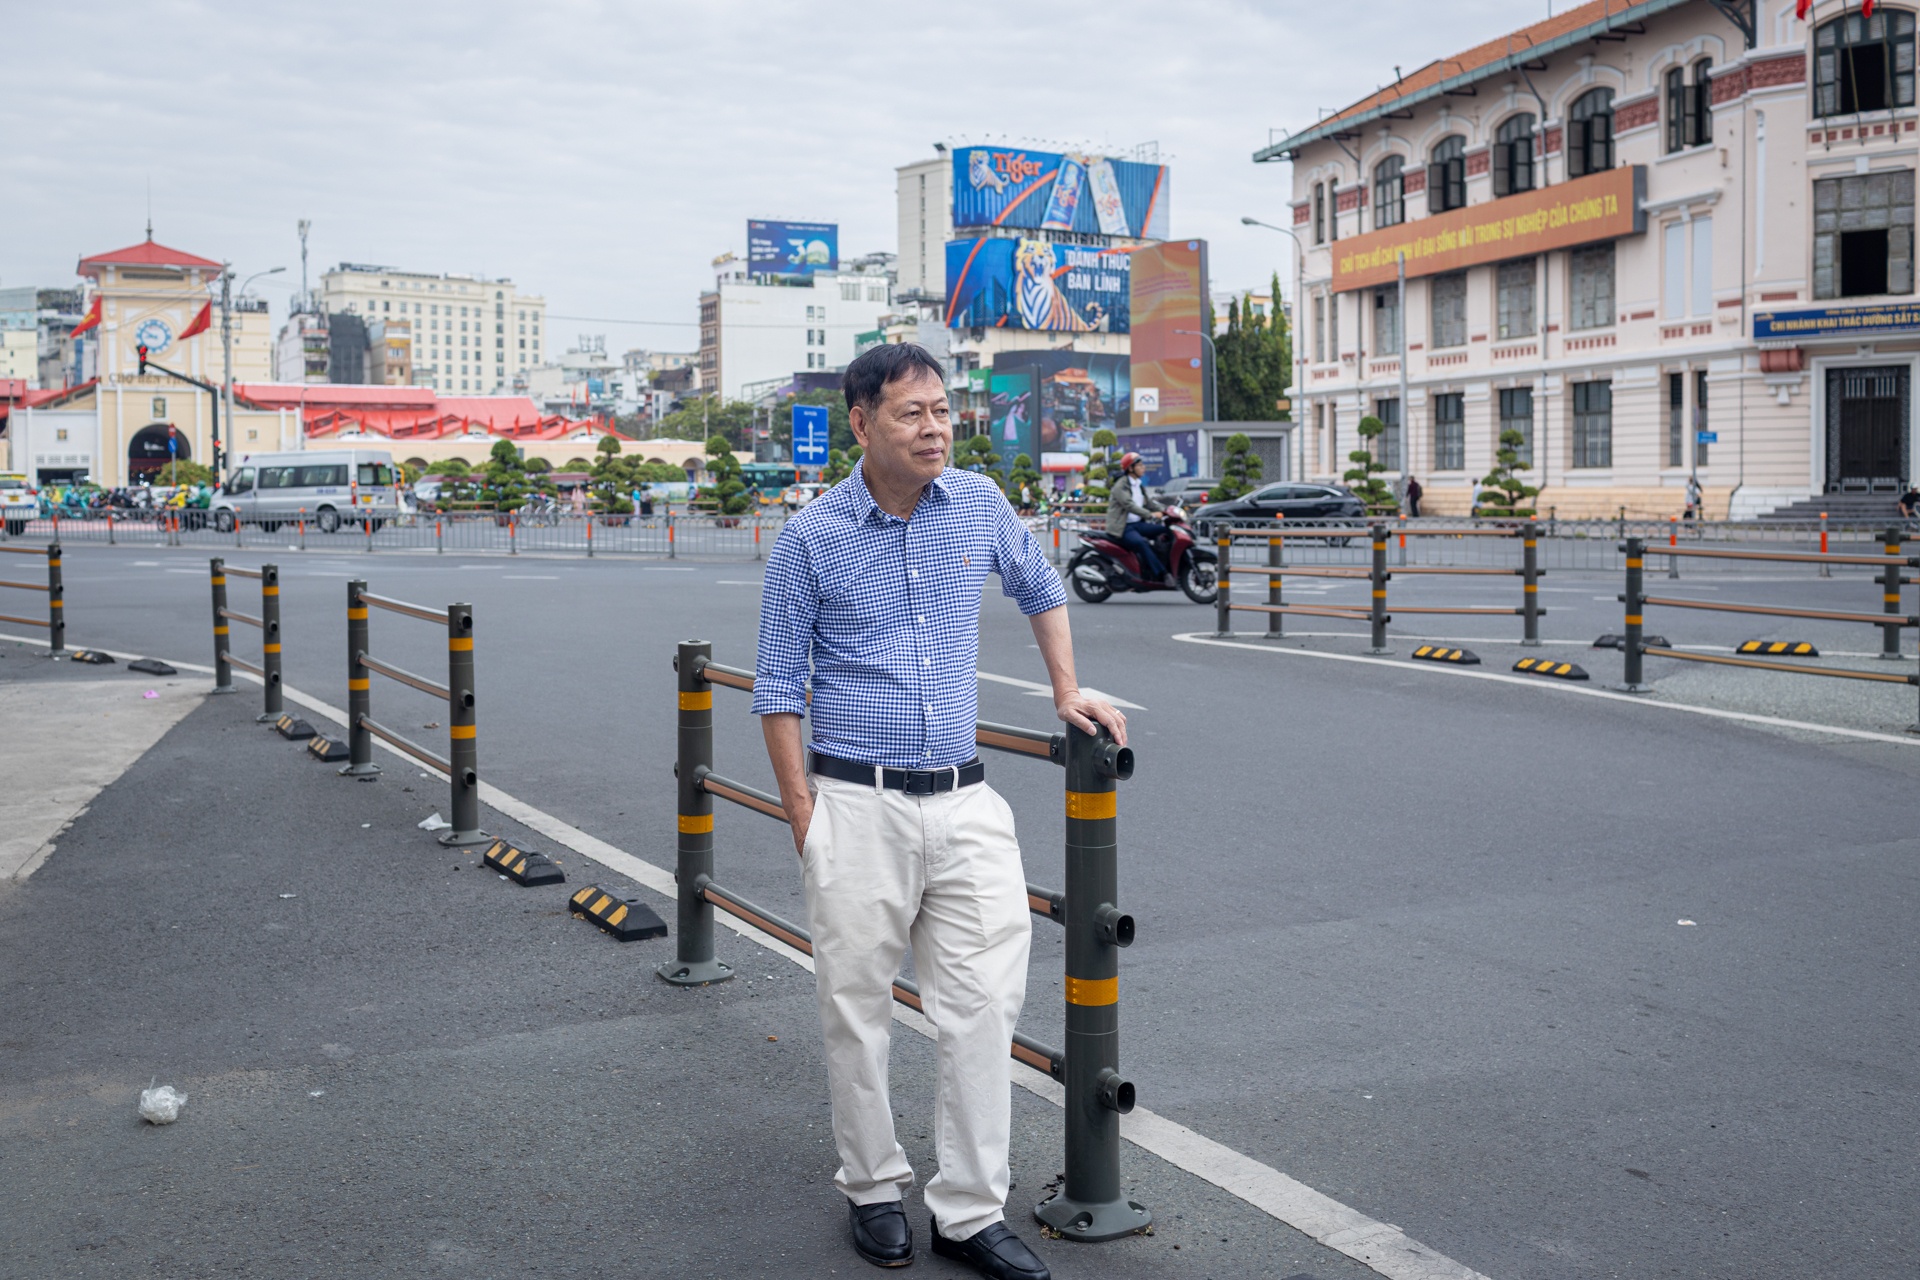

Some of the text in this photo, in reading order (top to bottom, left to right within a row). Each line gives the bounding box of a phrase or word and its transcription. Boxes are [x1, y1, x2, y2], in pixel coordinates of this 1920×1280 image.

[993, 152, 1042, 183] Tiger
[1474, 220, 1501, 244] TRONG
[1516, 208, 1548, 235] NGHIỆP
[1549, 201, 1568, 229] CỦA
[1569, 196, 1602, 224] CHÚNG
[1604, 194, 1618, 216] TA
[1067, 268, 1091, 290] BẢN
[1094, 271, 1121, 293] LĨNH
[1770, 320, 1785, 332] CHI
[1786, 317, 1816, 331] NHÁNH
[1817, 317, 1837, 329] KHAI
[1838, 314, 1861, 328] THÁC
[1894, 310, 1912, 324] SẮT
